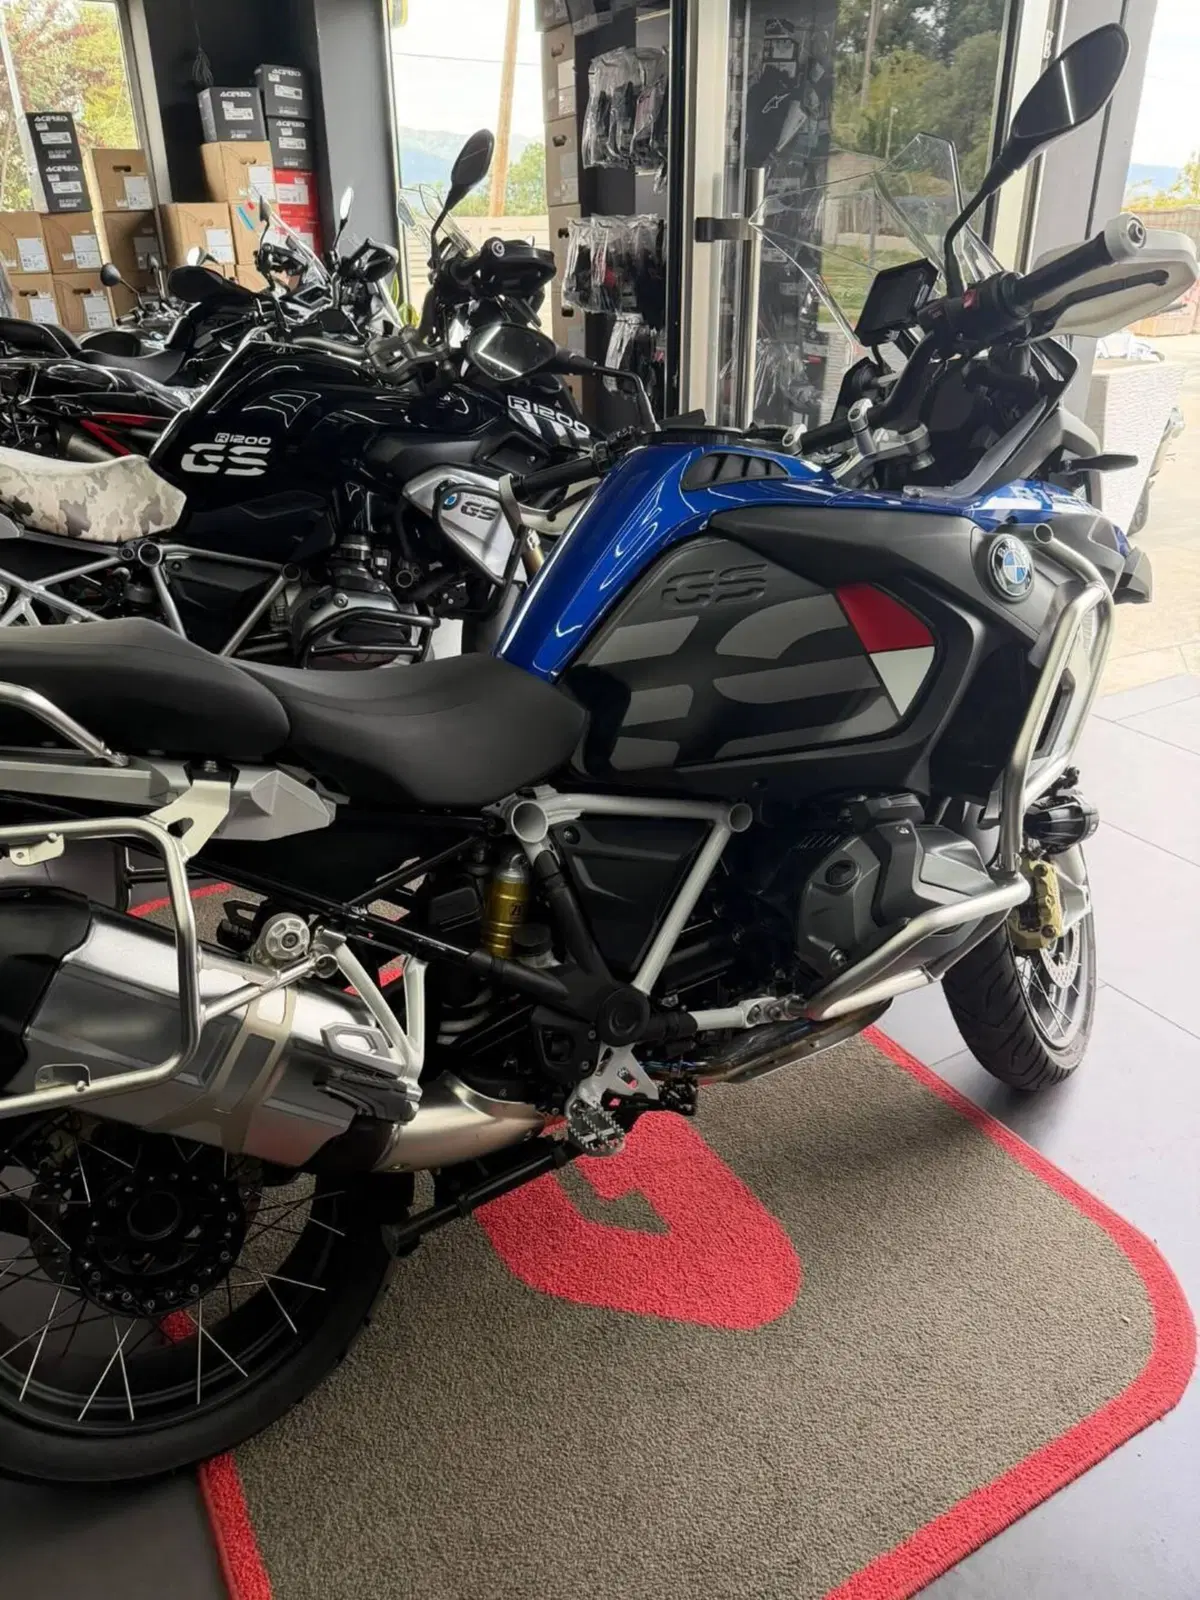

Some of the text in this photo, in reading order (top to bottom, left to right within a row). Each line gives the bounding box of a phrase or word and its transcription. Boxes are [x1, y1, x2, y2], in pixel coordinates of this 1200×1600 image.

[180, 443, 272, 476] GS
[460, 501, 499, 521] GS
[661, 563, 768, 606] GS
